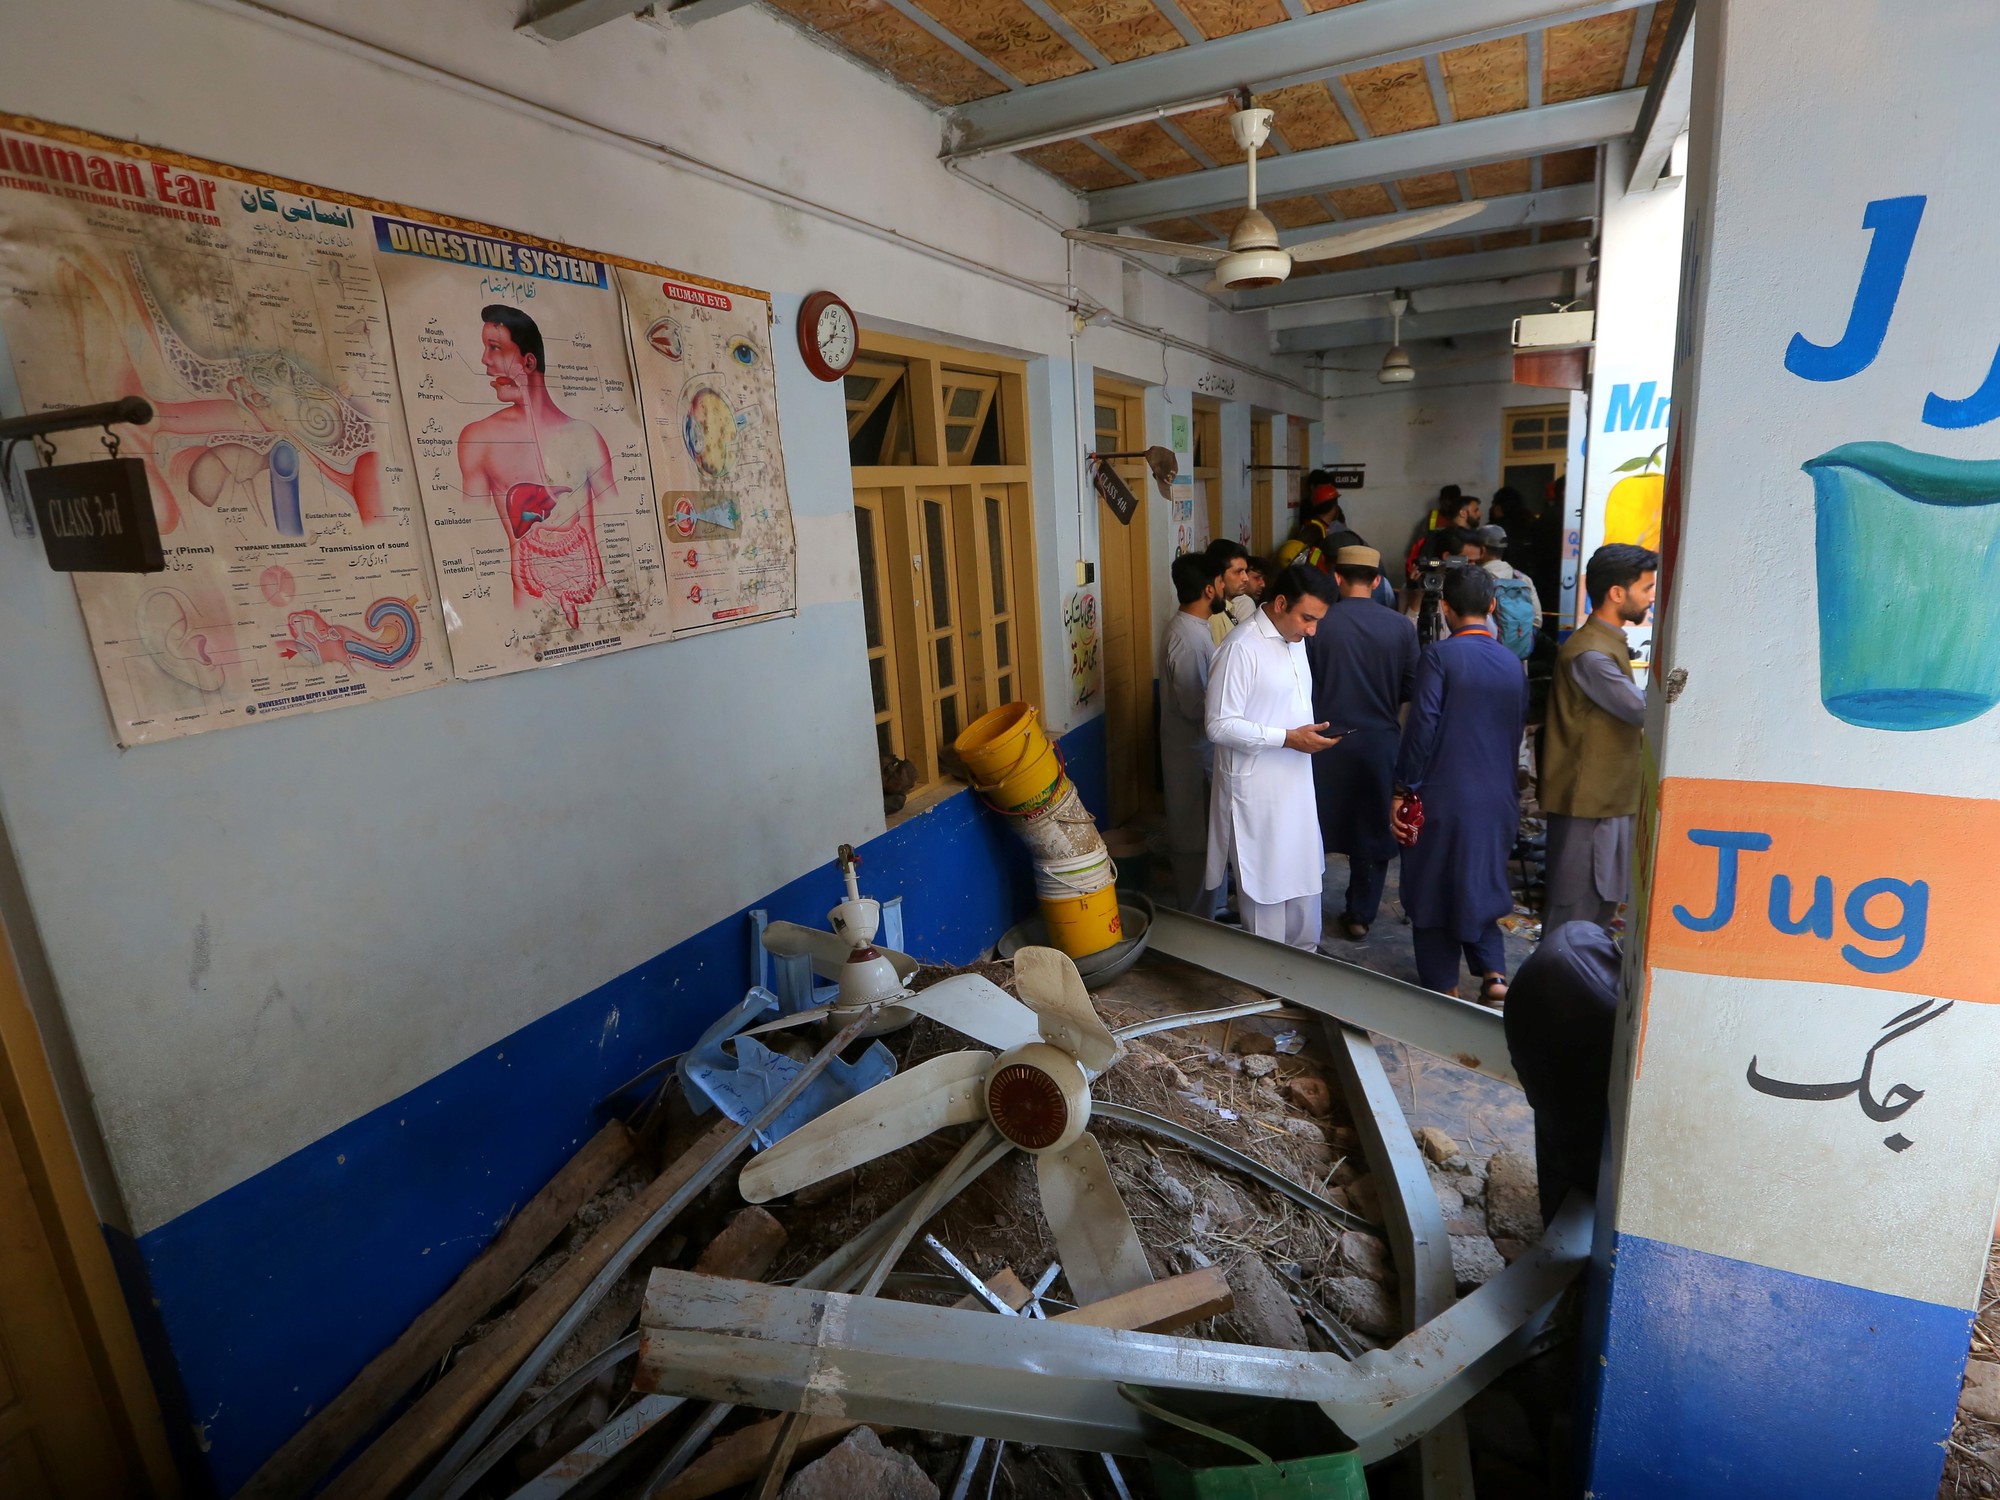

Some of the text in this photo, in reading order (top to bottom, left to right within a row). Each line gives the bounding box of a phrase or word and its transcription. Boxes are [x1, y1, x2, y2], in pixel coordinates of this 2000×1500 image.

[151, 162, 217, 211] Ear
[63, 187, 121, 209] EXTERNAL
[121, 199, 186, 221] STRUCTURE
[187, 211, 201, 223] OF
[202, 213, 222, 227] EAR
[241, 187, 354, 229] انسانی کان
[185, 236, 228, 250] Middle ear
[246, 247, 289, 260] Internal ear
[387, 221, 600, 286] DIGESTIVE SYSTEM
[1783, 195, 1928, 383] J
[247, 291, 290, 303] Semi-circular
[668, 285, 728, 309] HUMAN EYE
[824, 311, 830, 320] 11
[830, 310, 838, 319] 12
[838, 315, 841, 323] 1
[292, 320, 313, 328] Round
[841, 325, 846, 333] 2
[424, 327, 445, 336] Mouth
[418, 334, 454, 347] (oral cavity)
[571, 340, 592, 349] Tongue
[842, 336, 847, 344] 3
[822, 351, 827, 359] 7
[828, 355, 833, 363] 6
[835, 353, 840, 362] 5
[560, 374, 585, 382] Sublingual
[604, 379, 625, 387] Salivary
[417, 391, 444, 401] Pharynx
[416, 437, 453, 447] Esophagus
[1100, 472, 1128, 513] CLASS 4th
[217, 506, 248, 514] Ear drum
[50, 493, 123, 538] CLASS 3rd
[305, 510, 352, 521] Eustachian tube
[434, 518, 472, 527] Gallbladder
[605, 536, 630, 544] Descending
[175, 545, 215, 556] (Pinna)
[235, 542, 308, 552] TYMPANIC MEMBRANE
[319, 543, 375, 553] Transmission
[387, 541, 410, 550] sound
[475, 547, 505, 555] Duodenum
[442, 558, 463, 567] Small
[478, 559, 501, 567] Jejunum
[638, 558, 653, 566] Large
[443, 565, 474, 575] intestine
[257, 697, 291, 709] UNIVERSITY
[291, 694, 306, 703] BOOK
[305, 691, 322, 700] DEPOT
[326, 688, 339, 696] NEW
[338, 686, 350, 694] MAP
[1672, 828, 1931, 975] Jug
[1745, 997, 1955, 1154] جگ
